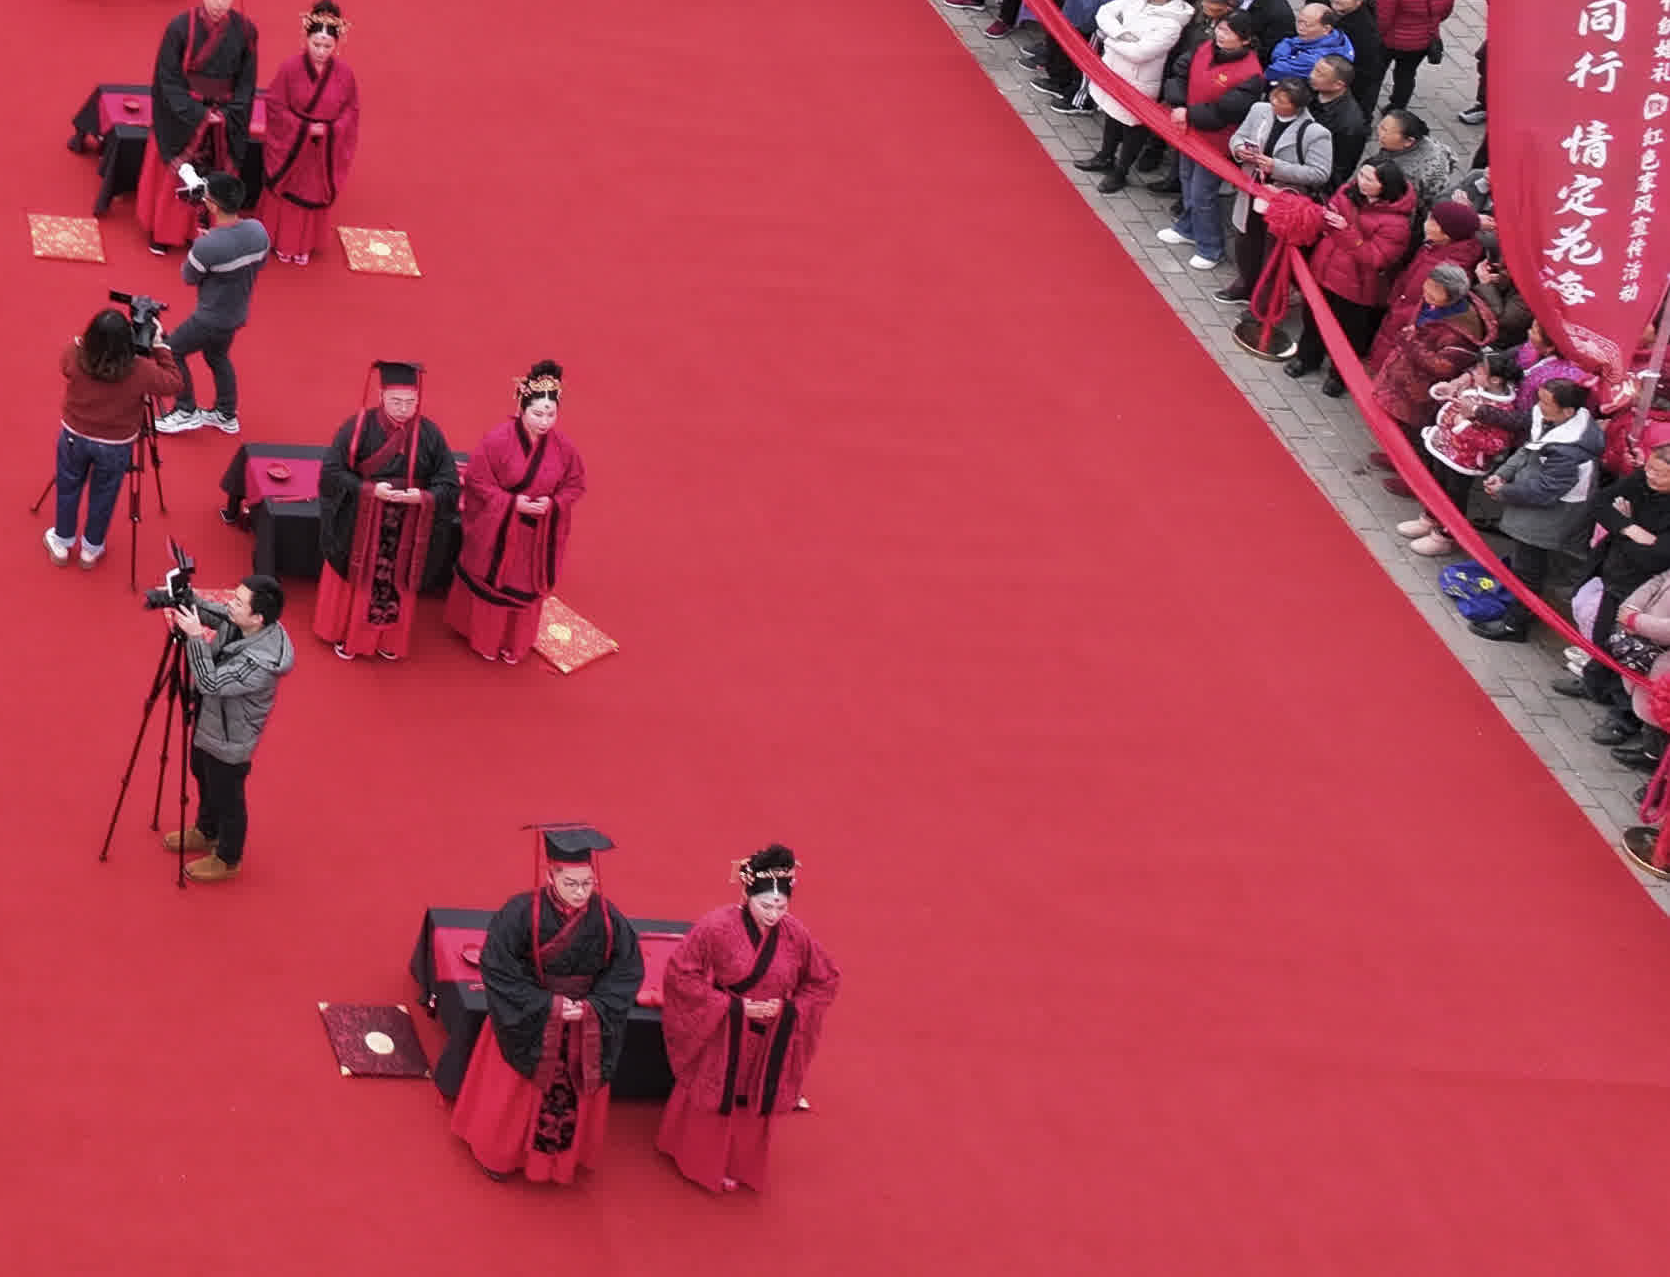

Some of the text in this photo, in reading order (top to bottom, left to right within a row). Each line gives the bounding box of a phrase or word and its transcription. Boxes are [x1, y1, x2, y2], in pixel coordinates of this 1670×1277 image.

[1544, 119, 1613, 305] 情定花海
[1618, 126, 1664, 303] 红色家风宣传活动
